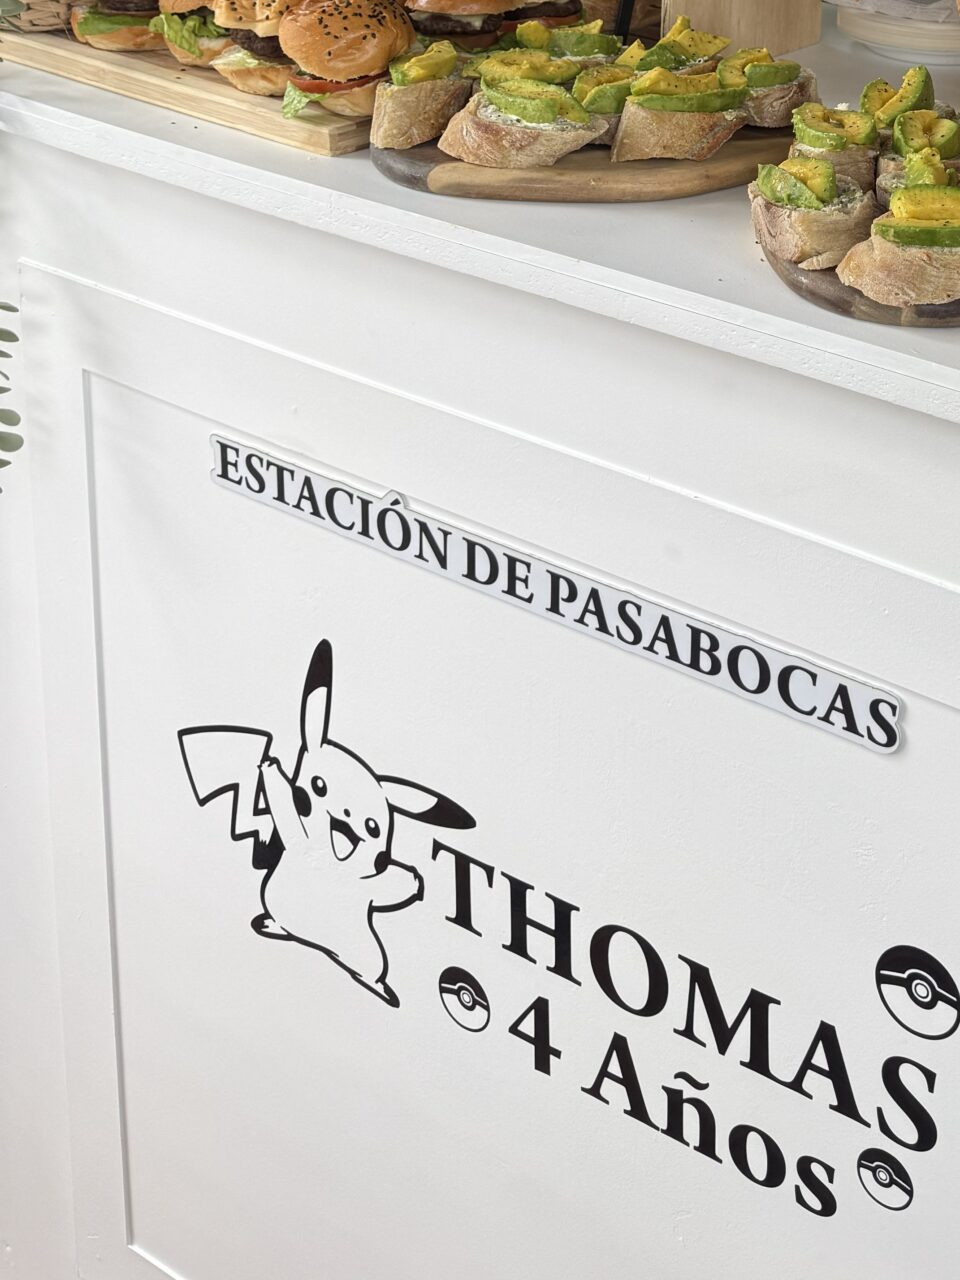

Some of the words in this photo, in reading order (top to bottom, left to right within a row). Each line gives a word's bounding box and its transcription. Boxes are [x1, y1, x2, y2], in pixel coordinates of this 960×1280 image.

[215, 439, 453, 571] ESTACIÓN
[461, 536, 535, 605] DE
[545, 569, 899, 749] PASABOCAS
[431, 837, 939, 1154] THOMAS
[508, 996, 563, 1077] 4
[580, 1030, 838, 1219] Años
